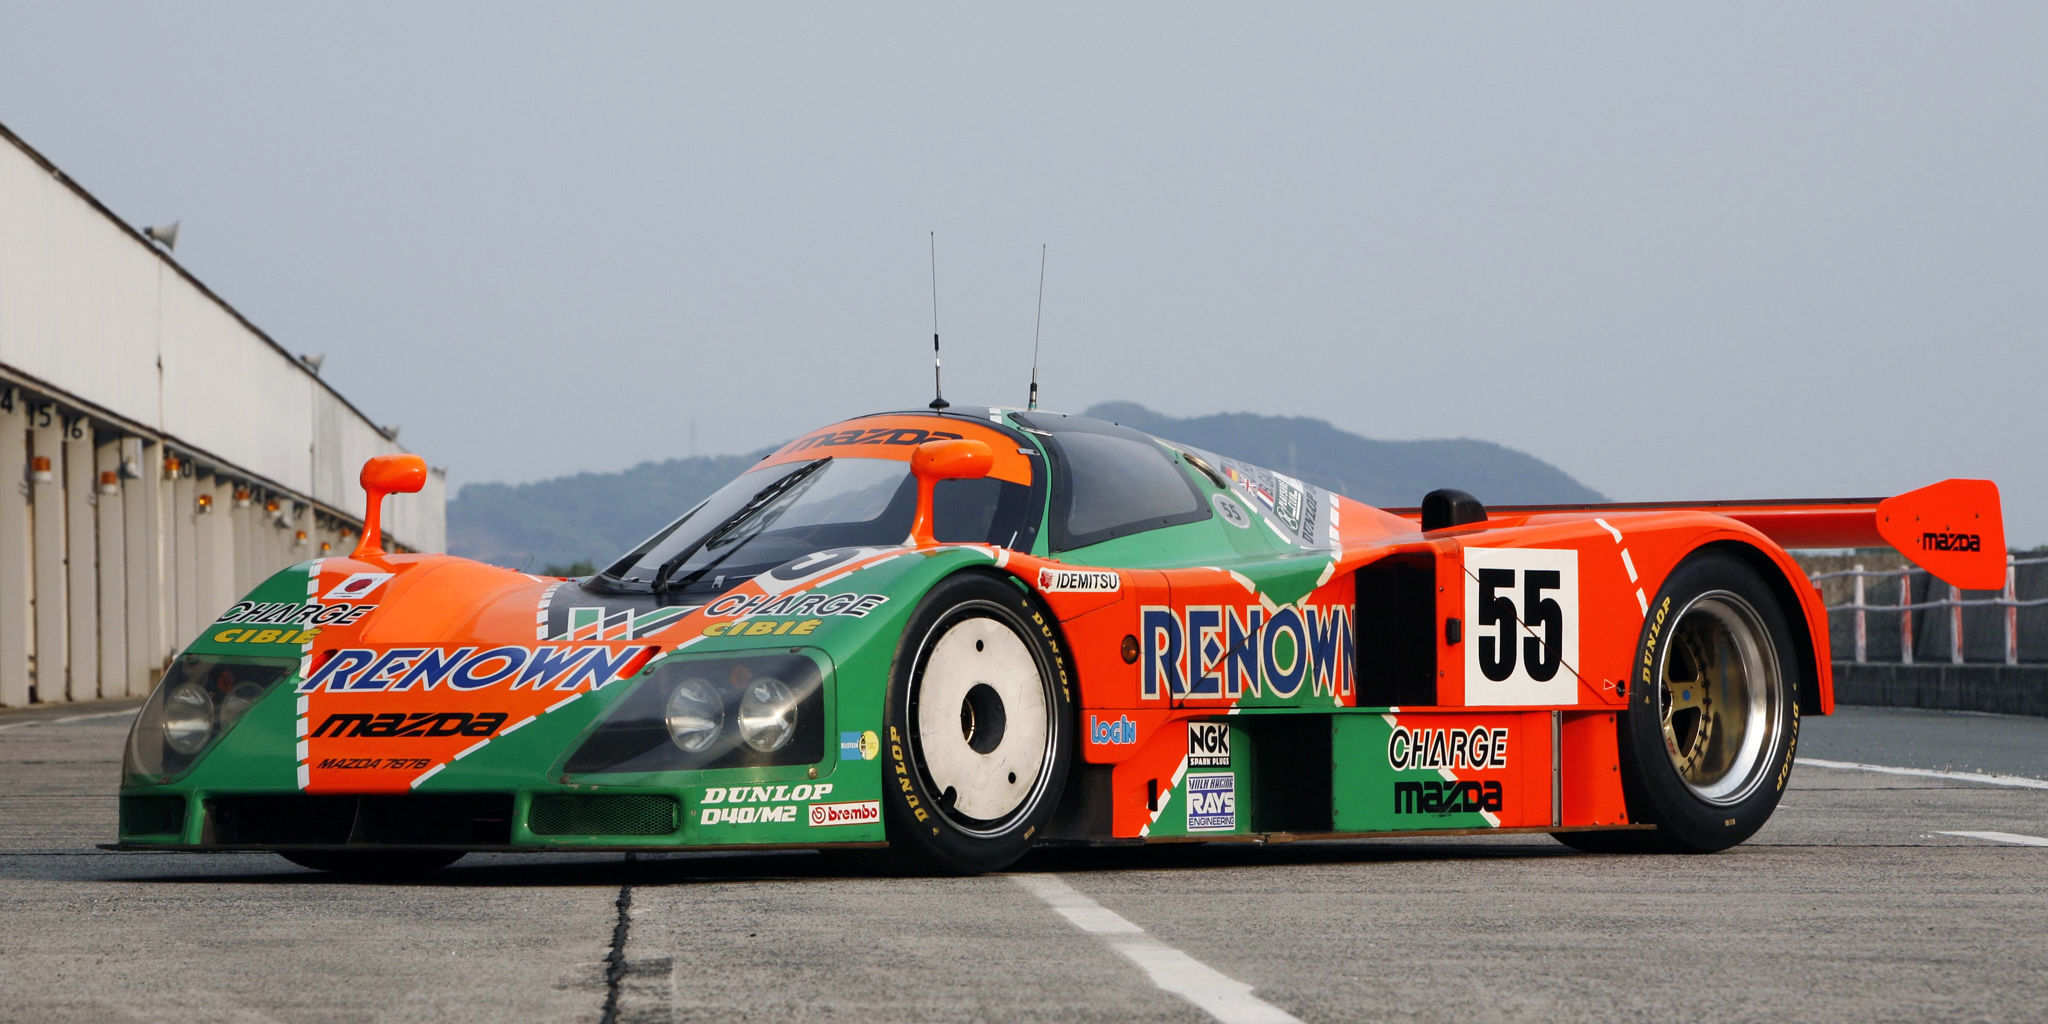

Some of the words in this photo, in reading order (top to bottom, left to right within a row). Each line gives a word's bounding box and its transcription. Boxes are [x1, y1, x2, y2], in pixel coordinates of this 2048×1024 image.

[1220, 501, 1242, 521] 55
[1302, 491, 1317, 544] DUNLOP
[1056, 572, 1118, 590] IDEMITSU
[217, 600, 379, 625] CHARGE
[704, 593, 890, 618] CHARGE
[1478, 568, 1562, 682] 55
[1642, 596, 1671, 686] DUNLOP
[295, 646, 654, 693] RENOWN
[1032, 611, 1070, 703] DUNLOP
[1190, 725, 1229, 754] NGK
[1388, 726, 1508, 771] CHARGE
[1776, 701, 1799, 791] DUNLOP
[318, 758, 381, 769] MAZDA
[890, 725, 929, 823] DUNLOP
[1190, 757, 1211, 766] SPARK
[1212, 757, 1230, 766] PLUGS
[700, 784, 833, 804] DUNLOP
[1189, 792, 1234, 814] RAYS
[700, 805, 797, 825] D40/M2
[828, 806, 878, 822] brembo
[1189, 816, 1234, 826] ENGINEERING
